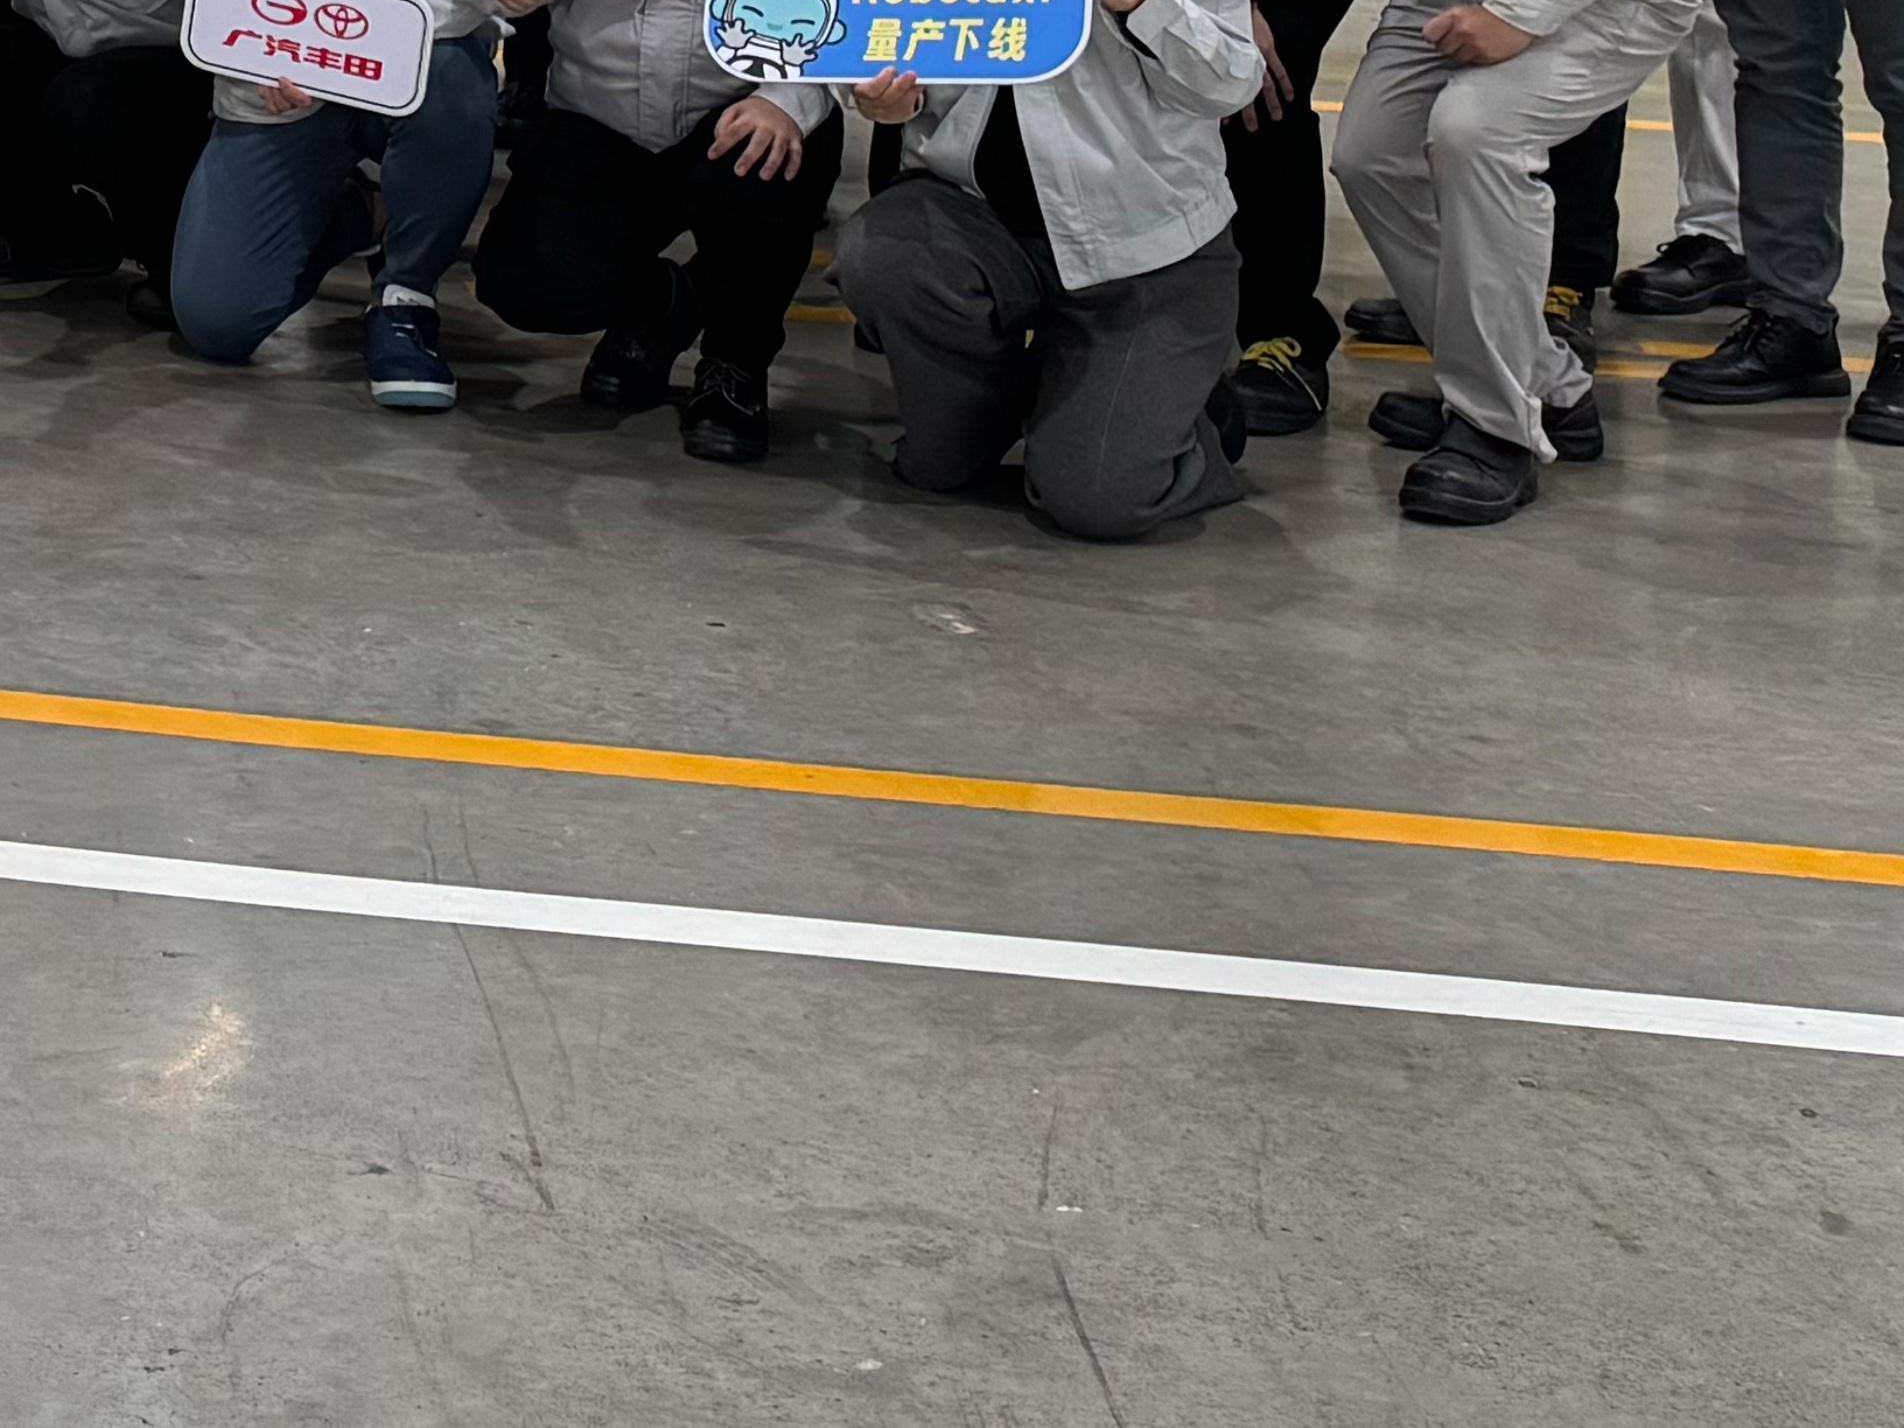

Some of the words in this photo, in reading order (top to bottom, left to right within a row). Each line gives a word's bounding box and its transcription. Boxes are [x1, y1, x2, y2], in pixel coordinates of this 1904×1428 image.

[221, 26, 385, 84] 广汽丰田
[862, 16, 1029, 64] 量产下线
